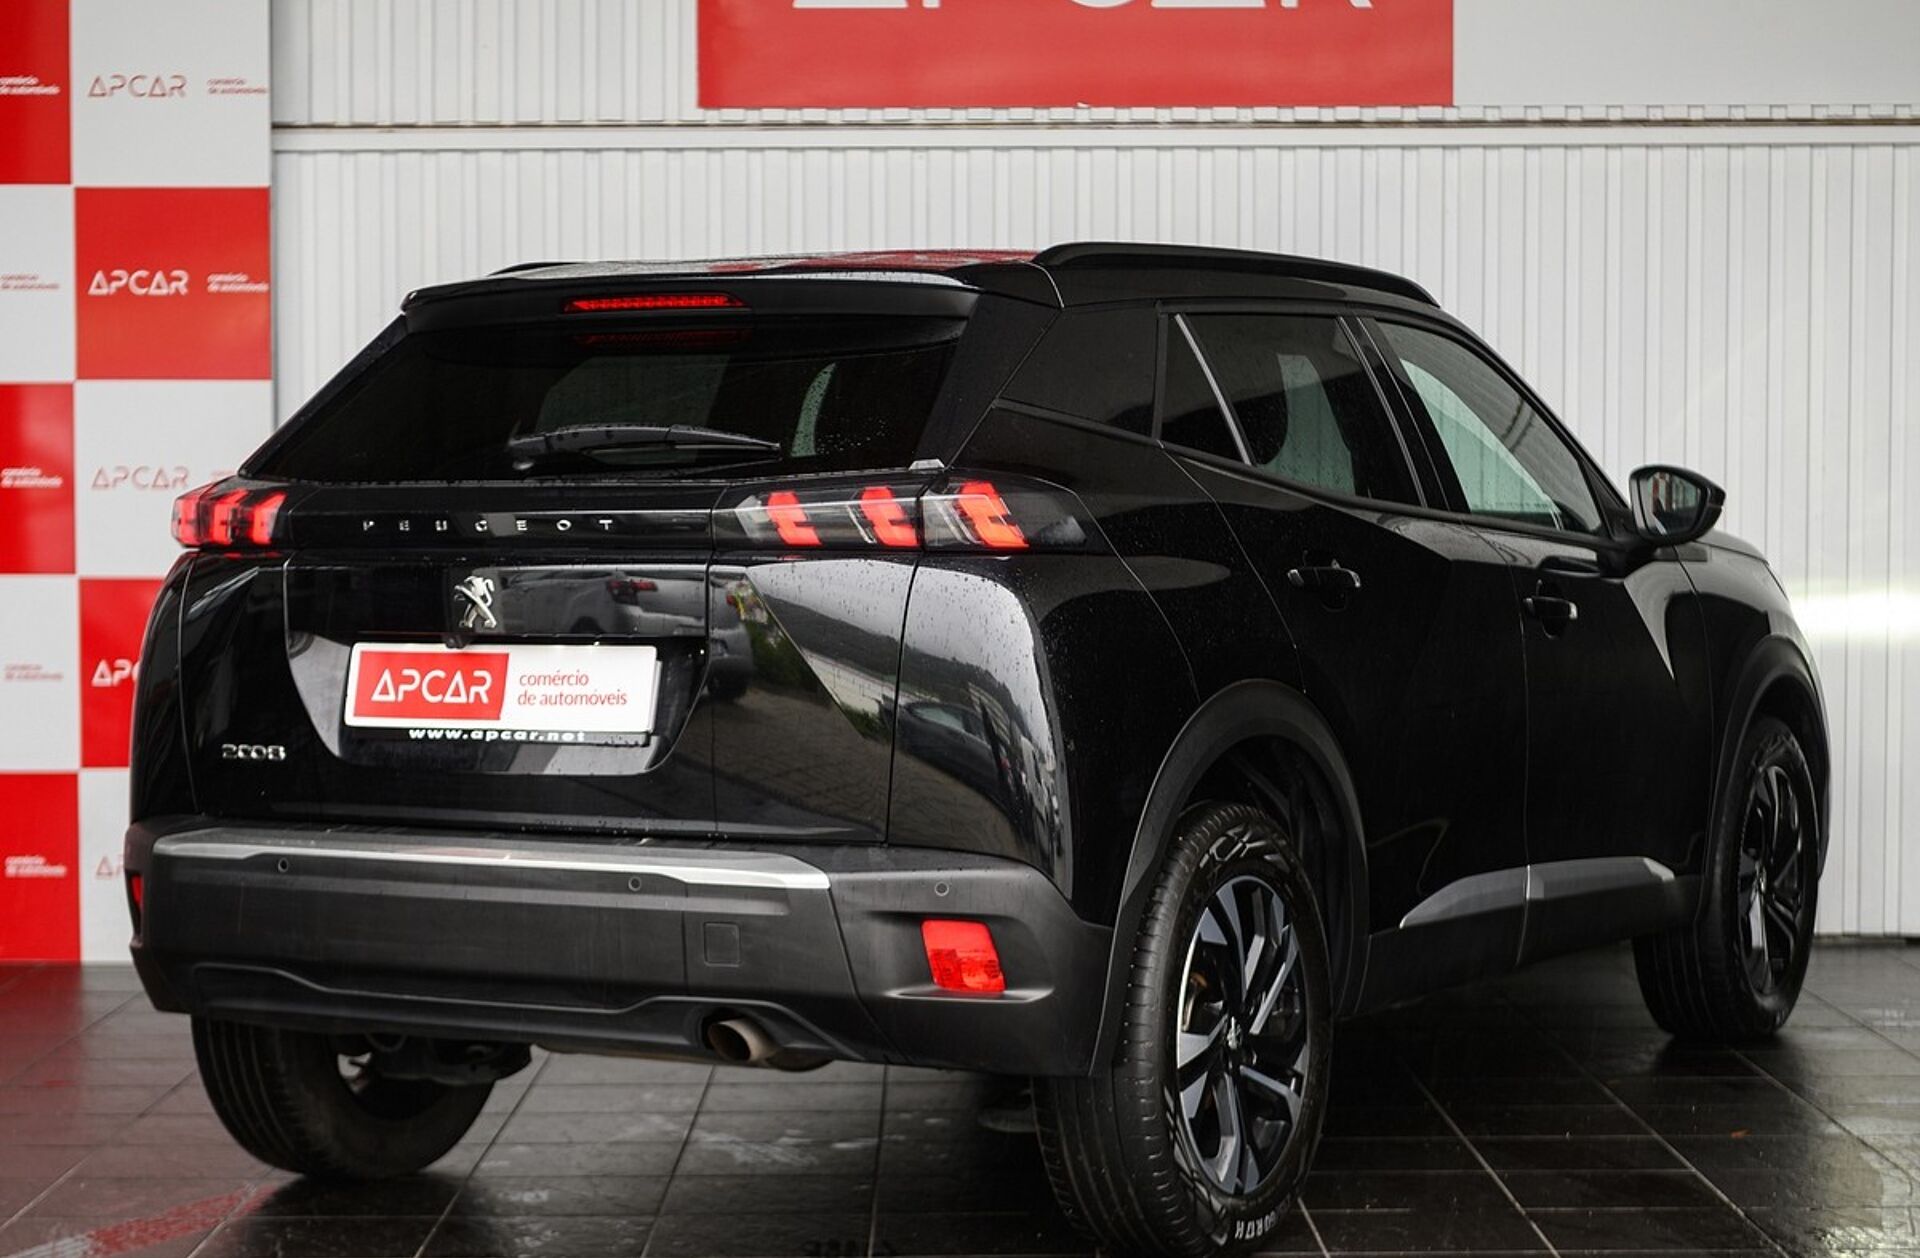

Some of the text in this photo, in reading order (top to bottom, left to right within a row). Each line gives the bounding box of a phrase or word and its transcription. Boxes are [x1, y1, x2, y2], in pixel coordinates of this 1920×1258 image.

[88, 74, 187, 97] APCAR
[88, 268, 189, 296] APCAR
[91, 466, 189, 490] APCAR
[363, 519, 613, 532] PEUGEOT
[371, 668, 492, 705] APCAR
[519, 669, 590, 687] comércio
[517, 689, 628, 706] de automóveis
[408, 728, 585, 742] www.apcar.net
[222, 744, 286, 760] 2008
